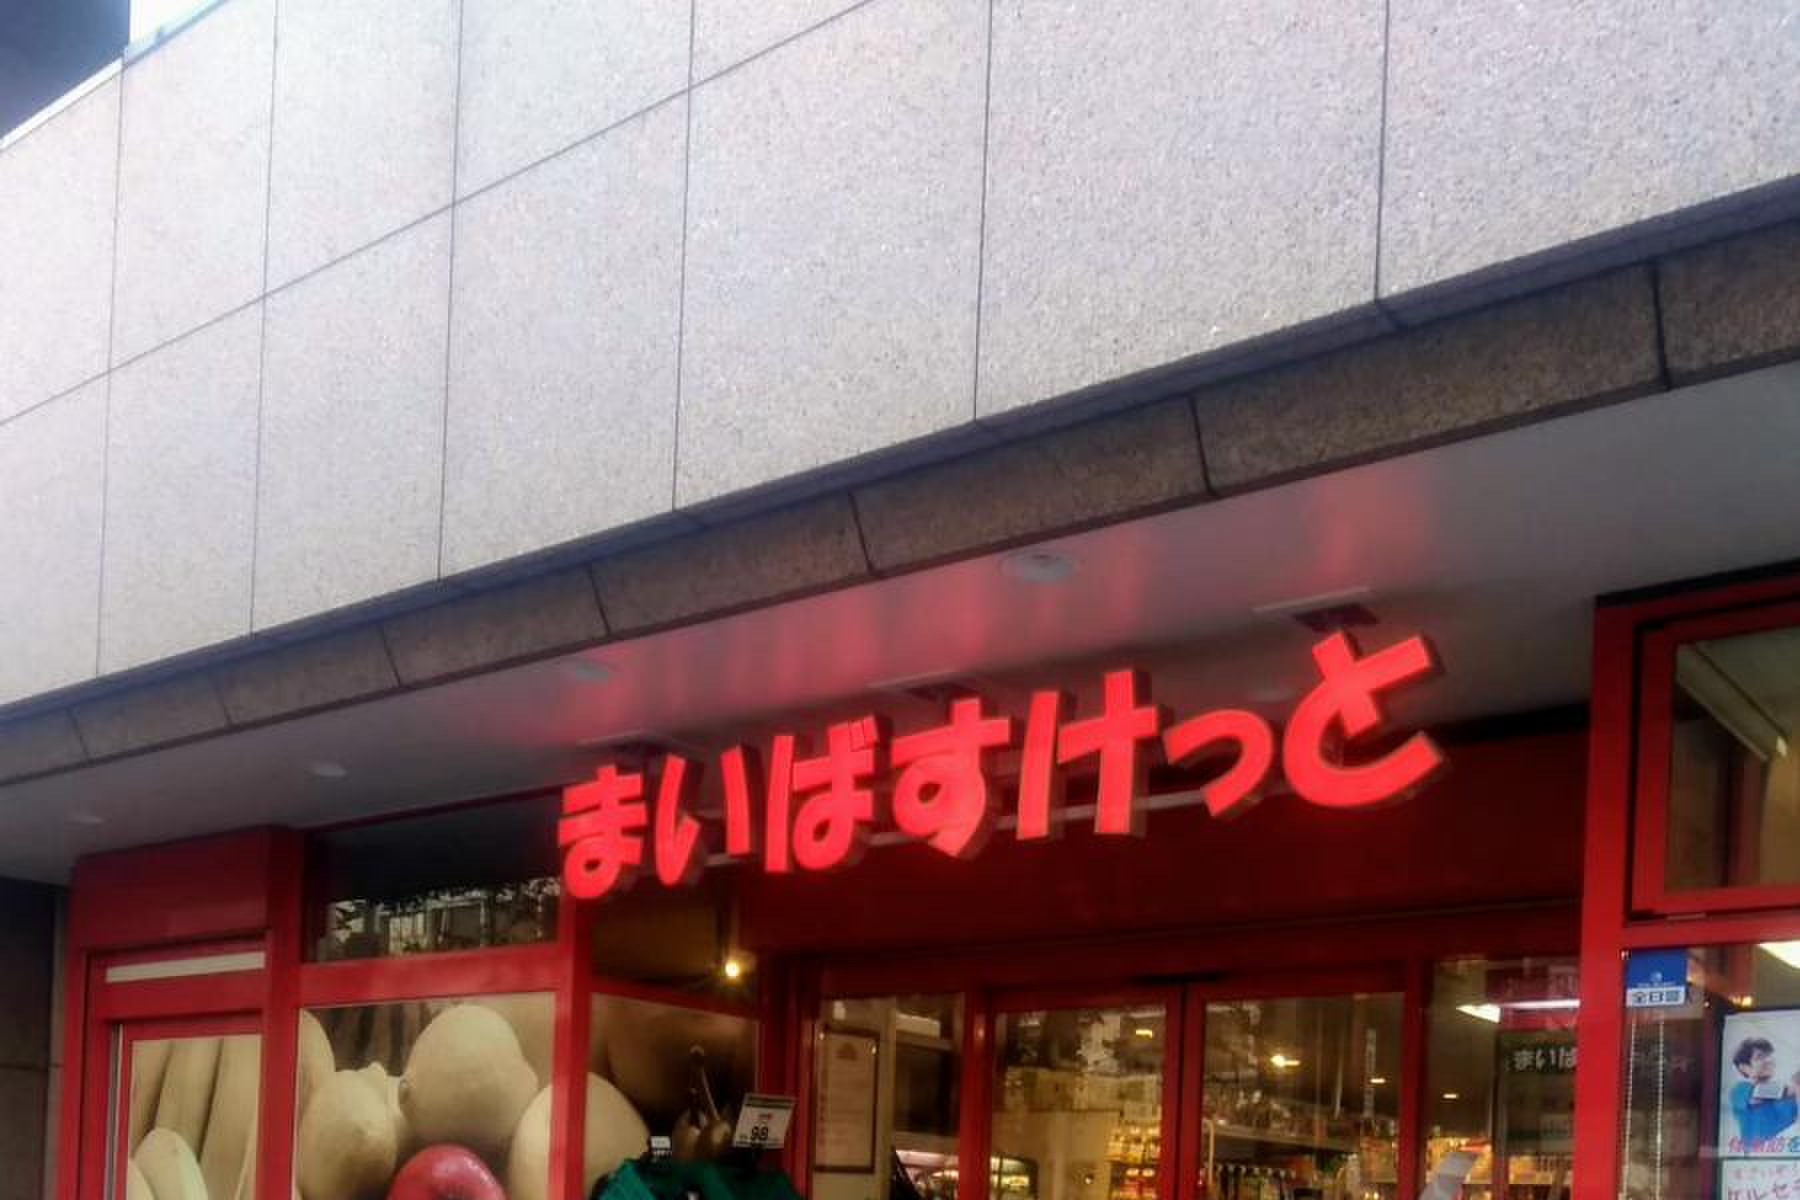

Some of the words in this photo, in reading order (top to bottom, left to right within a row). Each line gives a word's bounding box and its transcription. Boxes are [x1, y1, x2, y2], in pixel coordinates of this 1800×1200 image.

[559, 630, 1444, 899] まいばすけっと
